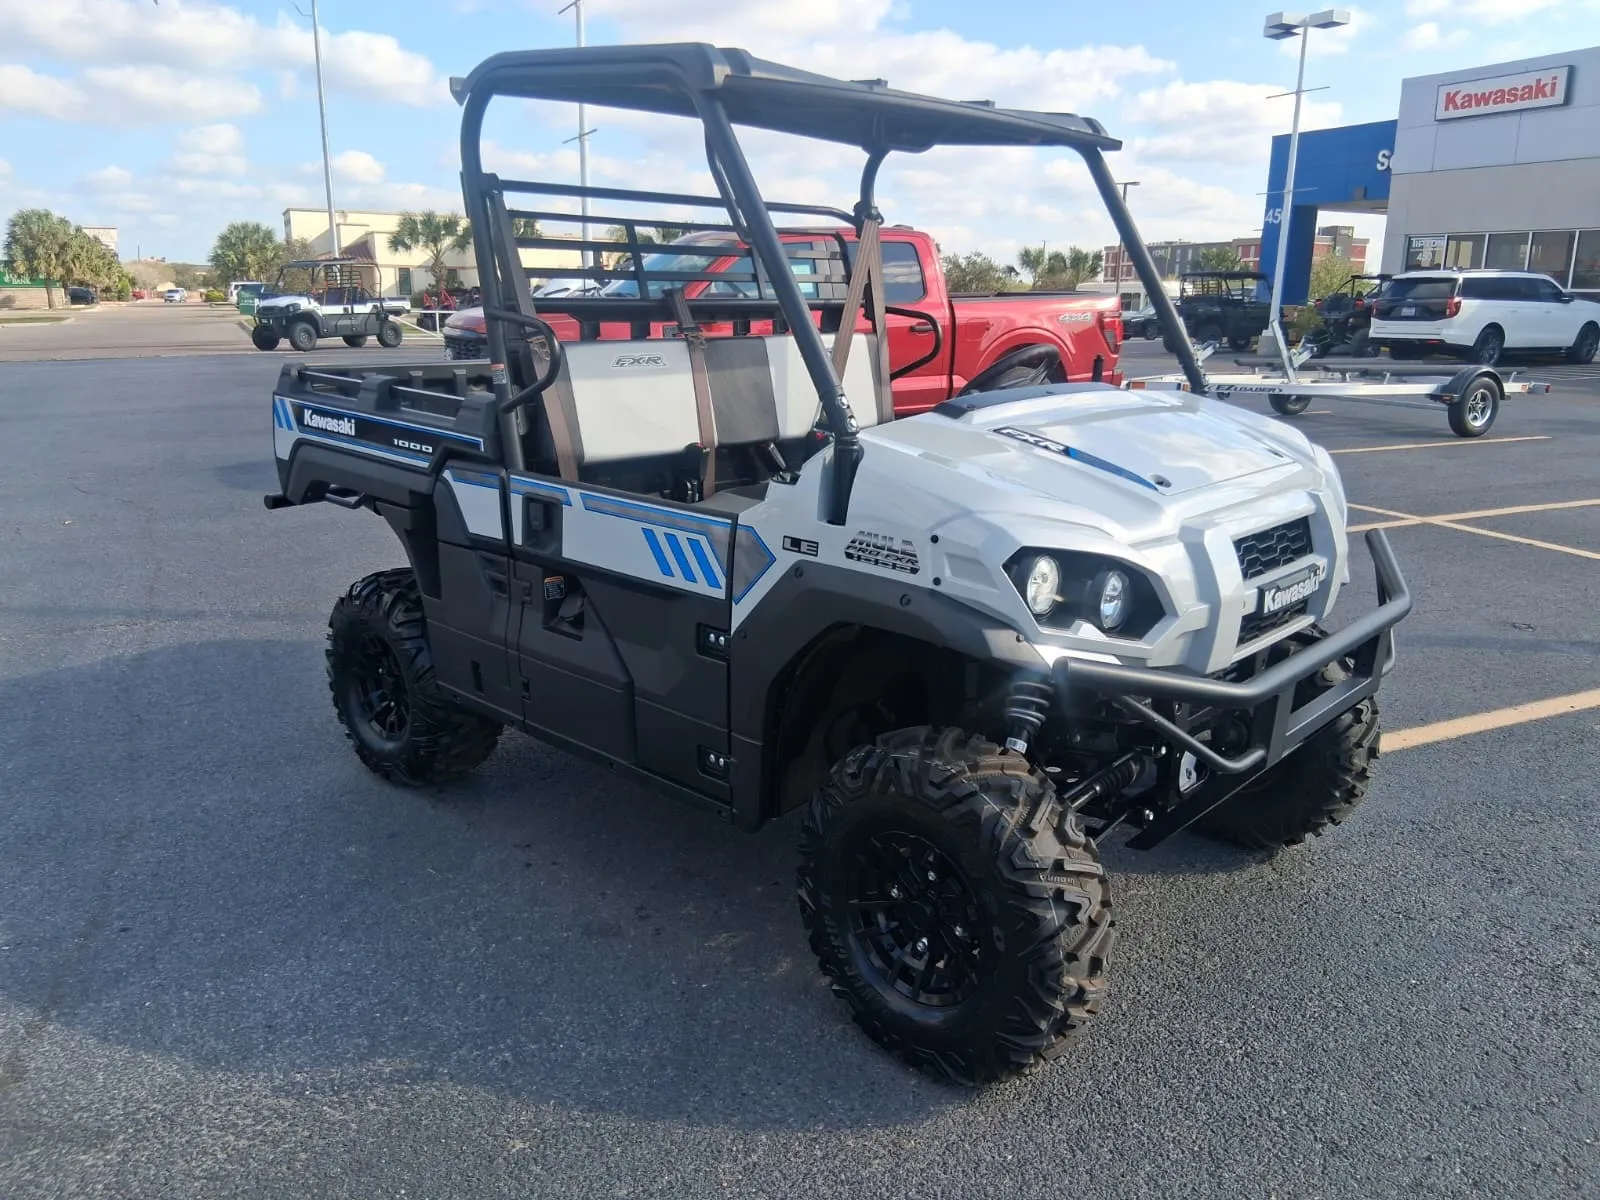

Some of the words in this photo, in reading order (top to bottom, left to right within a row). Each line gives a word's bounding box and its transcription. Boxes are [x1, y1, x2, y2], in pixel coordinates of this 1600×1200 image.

[1444, 75, 1558, 112] Kawasaki
[303, 408, 356, 436] Kawasaki
[392, 438, 433, 453] 1000
[998, 428, 1067, 455] FXR
[784, 537, 817, 556] LE
[849, 530, 918, 558] MULE
[1263, 571, 1320, 614] Kawasaki
